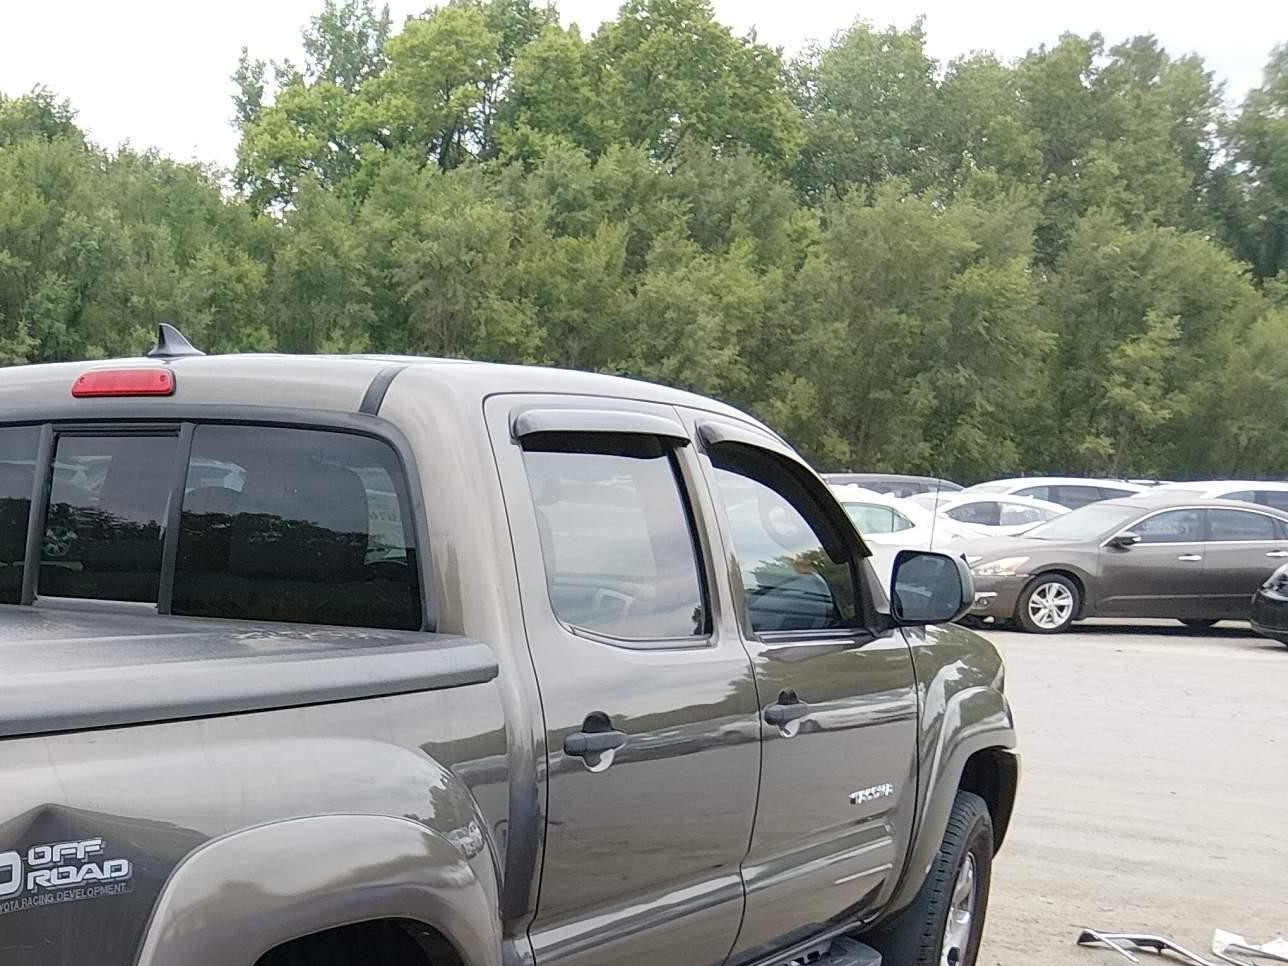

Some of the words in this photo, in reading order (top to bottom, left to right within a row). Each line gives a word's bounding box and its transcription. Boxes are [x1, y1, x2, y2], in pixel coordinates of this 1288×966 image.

[27, 838, 104, 866] OFF
[27, 859, 131, 891] ROAD
[22, 893, 54, 909] RACING
[56, 883, 128, 902] DEVELOPMENT
